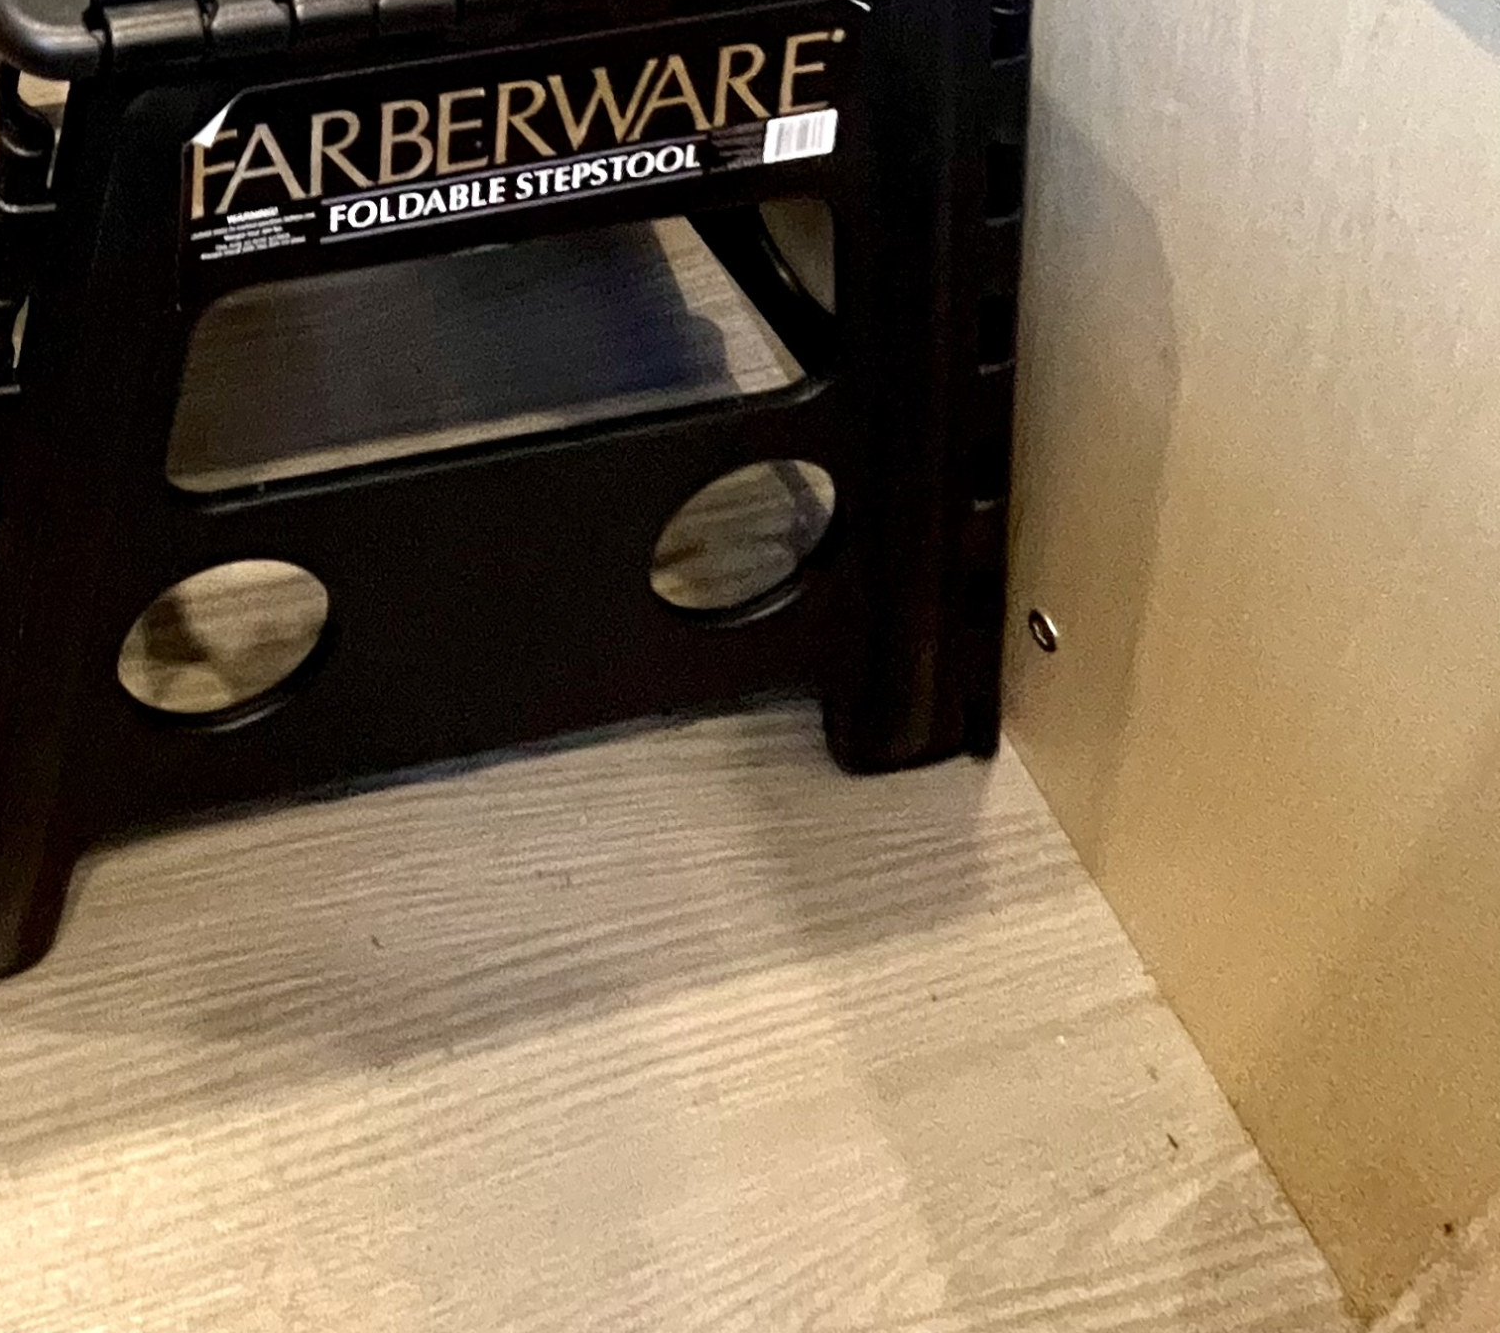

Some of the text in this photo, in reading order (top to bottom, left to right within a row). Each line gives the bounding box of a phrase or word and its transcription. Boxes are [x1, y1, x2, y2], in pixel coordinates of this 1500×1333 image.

[190, 31, 831, 220] FARBERWARE
[329, 176, 507, 233] FOLDABLE
[514, 144, 701, 200] STEPSTOOL
